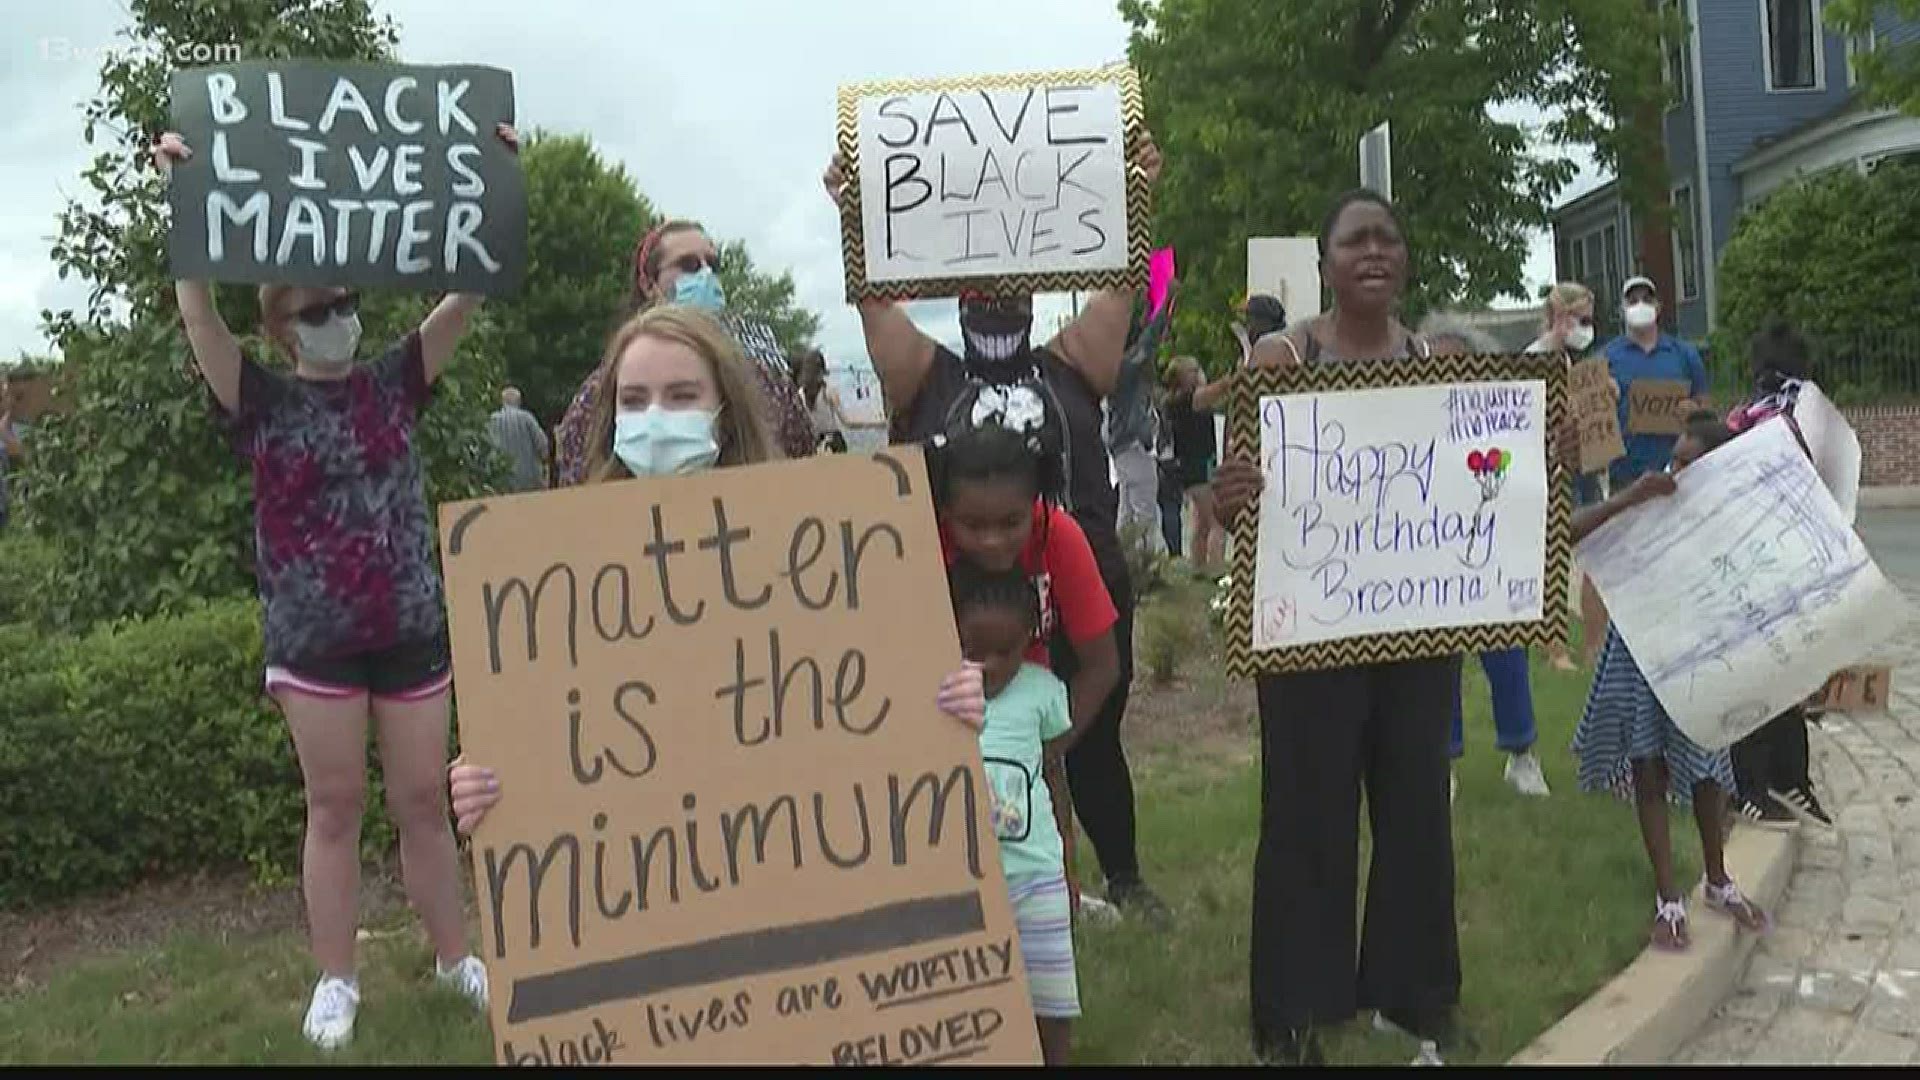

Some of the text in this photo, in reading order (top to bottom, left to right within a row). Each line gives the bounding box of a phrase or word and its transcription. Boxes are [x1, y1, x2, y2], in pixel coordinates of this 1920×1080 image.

[206, 72, 477, 135] BLACK
[878, 87, 1107, 147] SAVE
[211, 131, 486, 199] LIVES
[885, 147, 1107, 214] BLACK
[206, 191, 500, 274] MATTER
[887, 206, 1106, 265] LIVES
[1263, 398, 1436, 508] Happy
[1282, 500, 1496, 570] Birthday
[482, 497, 902, 674] matter
[567, 628, 890, 785] is the
[484, 764, 984, 958] minimum
[503, 937, 1012, 1067] black lives are WORTHY
[831, 1007, 1004, 1067] BELOVED
